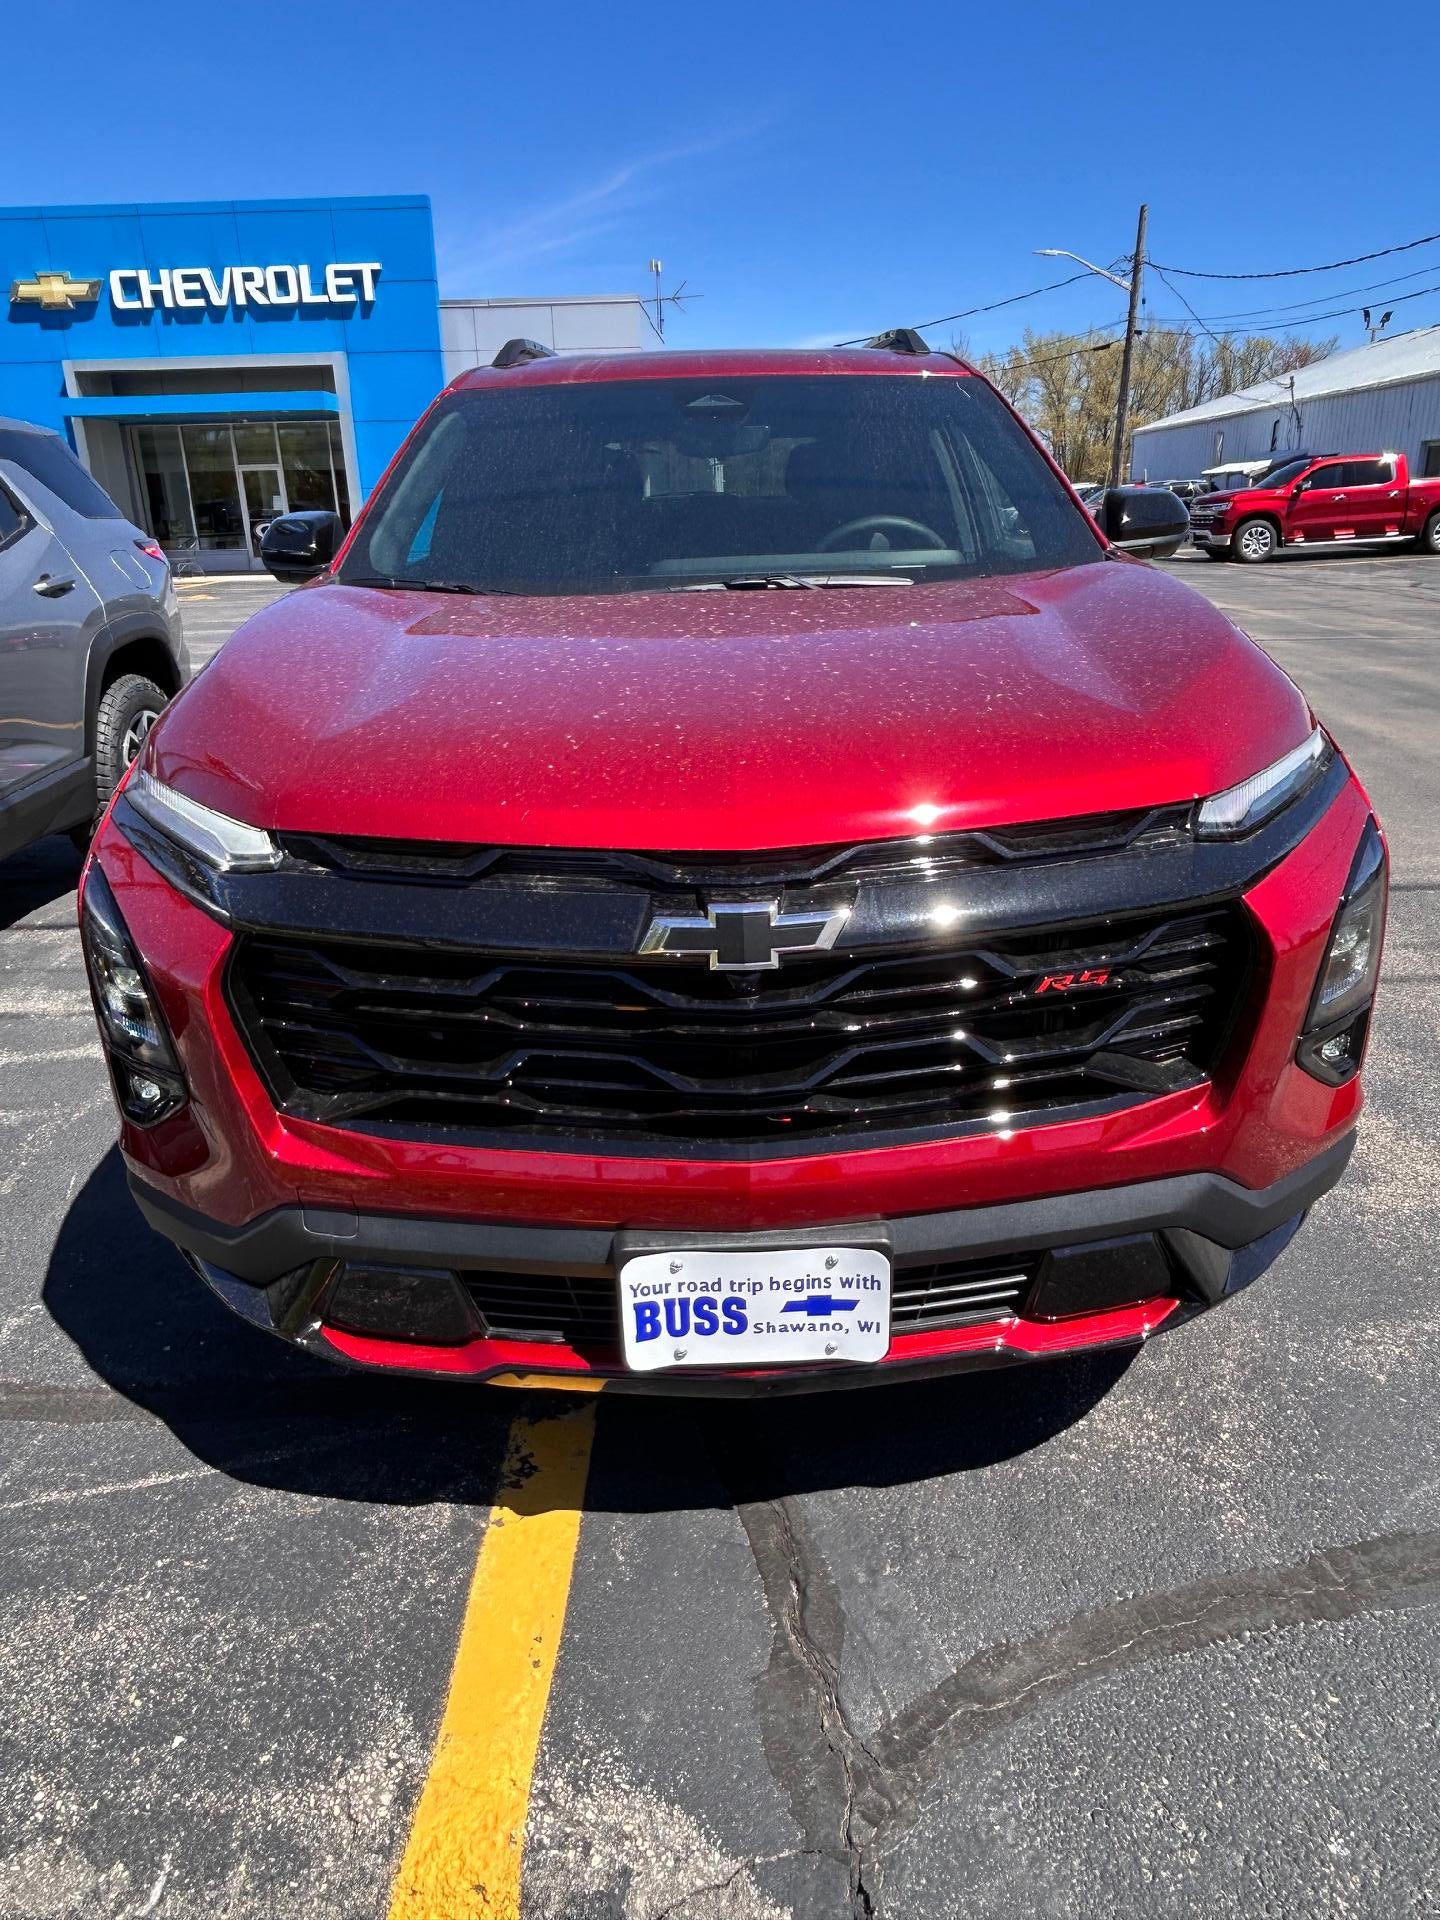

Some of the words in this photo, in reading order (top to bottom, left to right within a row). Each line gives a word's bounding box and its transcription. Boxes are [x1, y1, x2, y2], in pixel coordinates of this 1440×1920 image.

[109, 262, 383, 310] CHEVROLET
[1034, 968, 1111, 994] RS
[629, 1283, 672, 1298] Your
[678, 1278, 722, 1294] road
[729, 1278, 764, 1295] trip
[769, 1274, 832, 1293] begins
[839, 1274, 882, 1291] with
[633, 1296, 749, 1343] BUSS
[753, 1321, 850, 1334] Shawano,
[857, 1320, 881, 1333] WI
